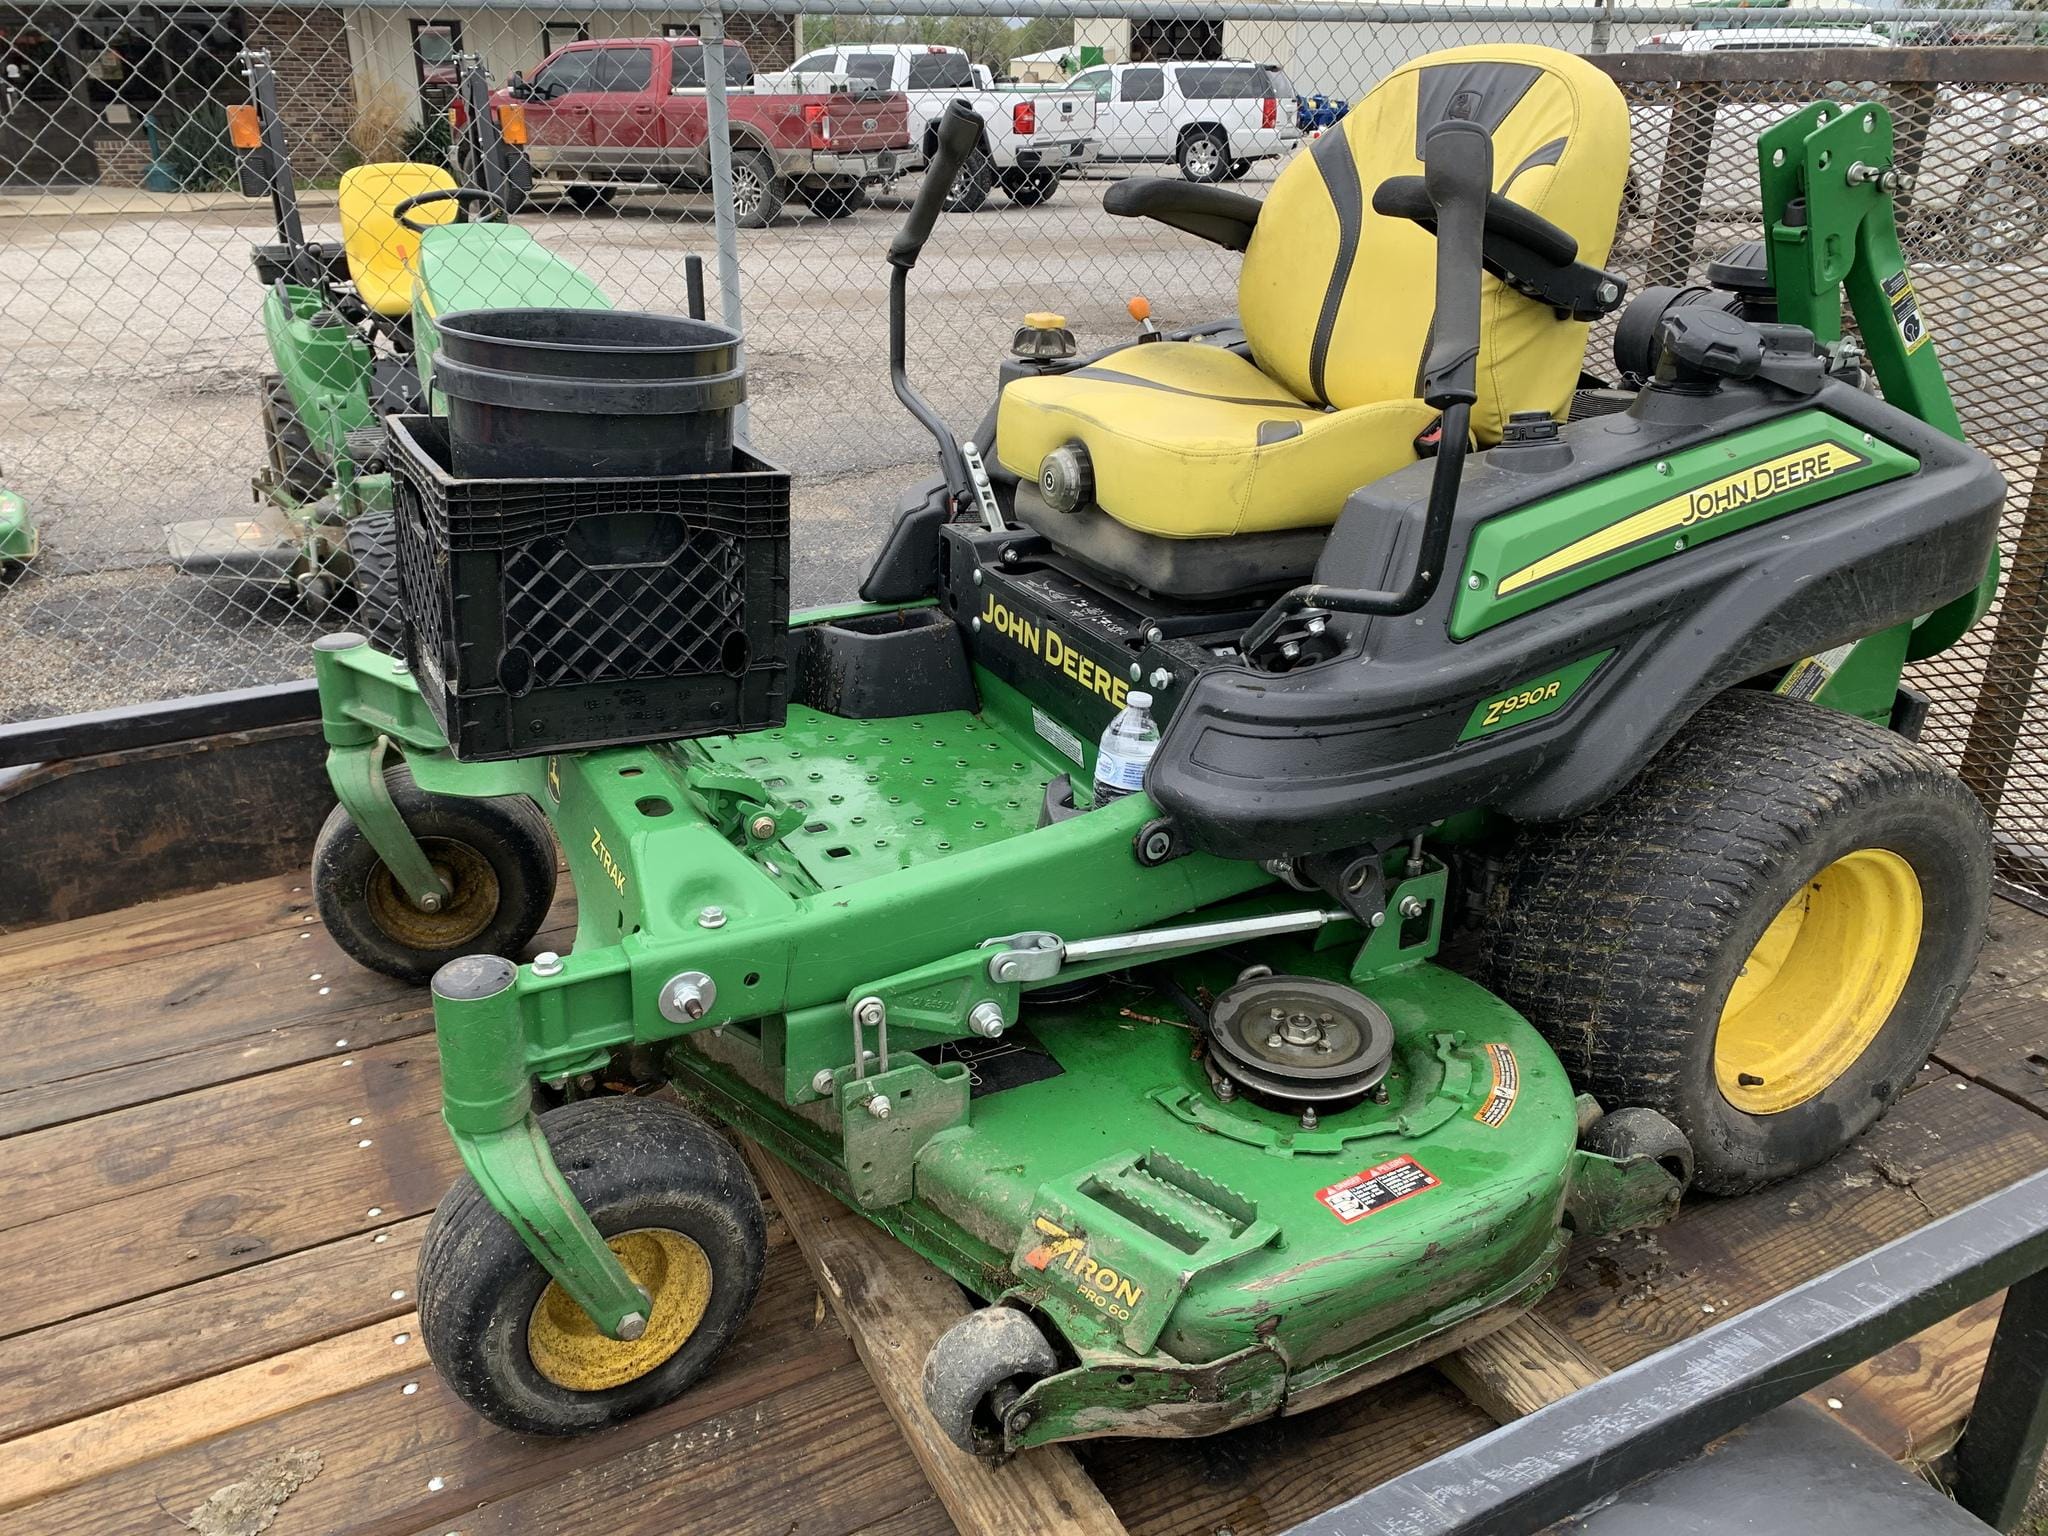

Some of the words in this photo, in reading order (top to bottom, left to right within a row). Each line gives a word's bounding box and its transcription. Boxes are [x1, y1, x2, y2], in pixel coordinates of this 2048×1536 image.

[1682, 480, 1749, 523] JOHN
[1754, 452, 1832, 496] DEERE
[982, 593, 1040, 655] JOHN
[1045, 629, 1129, 711] DEERE
[1482, 681, 1561, 726] Z930R
[591, 825, 626, 897] ZTRAK
[1077, 1285, 1106, 1306] PRO
[1108, 1304, 1130, 1321] 60
